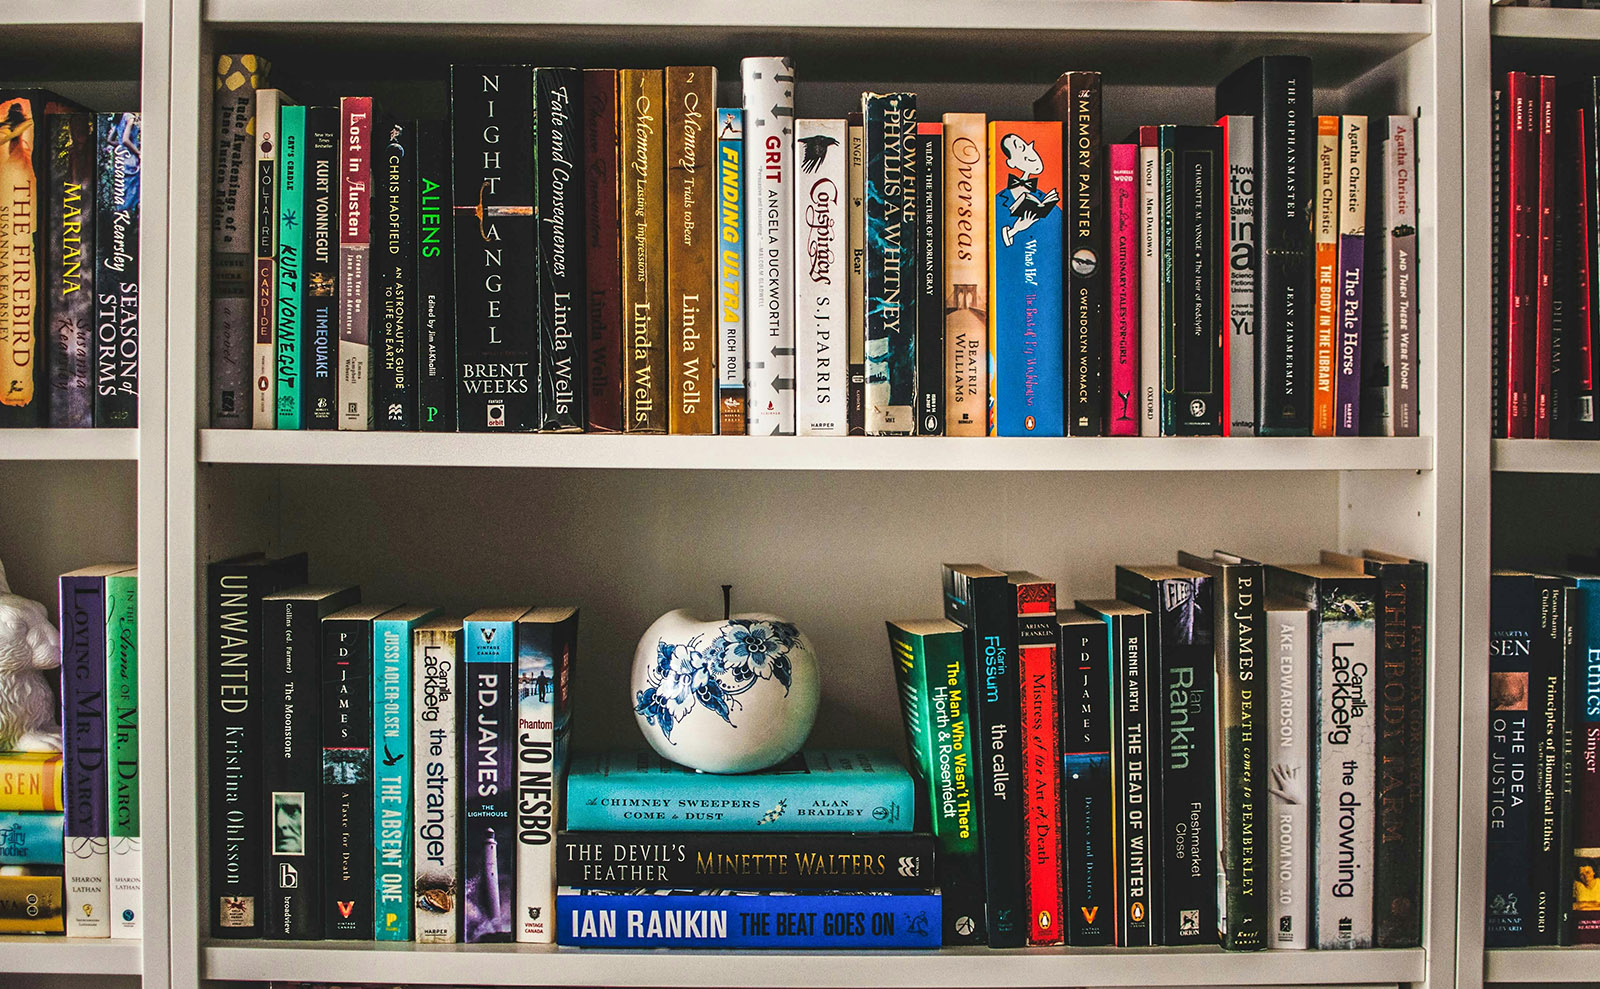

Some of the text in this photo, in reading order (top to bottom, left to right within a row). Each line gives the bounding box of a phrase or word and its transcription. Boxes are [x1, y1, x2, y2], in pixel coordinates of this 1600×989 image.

[235, 97, 249, 128] Rude
[1287, 79, 1296, 219] THE ORPHANMASTER
[226, 134, 245, 211] Awakenings
[286, 135, 295, 191] CAT'S CRADLE
[347, 112, 367, 236] Lost in Austen
[544, 86, 572, 277] Fate and Consequences
[766, 135, 781, 184] GRIT
[852, 137, 862, 167] ENGEL
[1195, 164, 1203, 208] CHARLOTTE
[225, 218, 236, 230] of
[422, 178, 440, 257] ALIENS
[722, 147, 739, 323] FINDING ULTRA
[882, 108, 901, 333] PHYLLIS A. WHITNEY
[925, 142, 934, 296] WILDE THE PICTURE OF DORIAN GRAY
[952, 137, 981, 261] Overseas
[1195, 211, 1203, 221] M.
[13, 180, 31, 367] THE FIREBIRD
[62, 182, 82, 296] MARIANA
[768, 189, 780, 337] ANGELA DUCKWORTH
[853, 248, 863, 275] Bear
[1024, 240, 1038, 285] What Ho!
[428, 295, 436, 317] Edited
[1193, 302, 1202, 336] Redclyffe
[1195, 276, 1203, 291] Heir
[1399, 250, 1408, 390] AND THEN THERE WERE NONE
[98, 293, 116, 397] STORMS
[118, 282, 139, 395] SEASON of
[315, 307, 328, 378] TIMEQUAKE
[385, 287, 394, 370] TO LIFE ON EARTH
[395, 267, 405, 389] AN ASTRONAUT'S GUIDE
[426, 320, 436, 328] by
[428, 330, 436, 342] Jim
[554, 293, 572, 414] Linda Wells
[727, 328, 737, 380] RICH ROLL
[1079, 288, 1088, 403] GWENDOLYN WOMACK
[1285, 286, 1293, 395] JEAN ZIMMERMAN
[1318, 265, 1332, 392] THE BODY IN THE LIBRARY
[1343, 269, 1359, 375] The Pale Horse
[1552, 300, 1562, 375] DILEMMA
[463, 364, 528, 378] BRENT
[463, 380, 528, 393] WEEKS
[954, 333, 966, 402] WILLIAMS
[968, 340, 979, 395] BEATRIZ
[219, 575, 249, 713] UNWANTED
[284, 603, 293, 674] Collins (ed. Farmer)
[1541, 589, 1549, 629] Childress
[1550, 589, 1559, 639] Beauchamp
[384, 631, 400, 738] JUSSI ADLER-OLSEN
[984, 636, 1001, 703] Fossum
[284, 682, 294, 759] The Moonstone
[519, 718, 553, 729] Phantom
[1169, 667, 1193, 770] Rankin
[421, 729, 449, 866] the stranger
[991, 724, 1009, 800] the caller
[1241, 689, 1254, 896] DEATH comes to PEMBERLEY
[1492, 719, 1506, 829] OF JUSTICE
[1511, 718, 1525, 807] THE IDEA
[1543, 676, 1557, 852] Principles of Biomedical Ethics
[341, 802, 350, 829] Taste
[341, 833, 350, 848] for
[381, 776, 402, 903] THE ABSENT ONE
[798, 809, 863, 817] BRADLEY
[1128, 723, 1144, 897] THE DEAD OF WINTER
[1175, 822, 1188, 859] Close
[1190, 802, 1202, 878] Fleshmarket
[1333, 760, 1361, 898] the drowning
[342, 852, 350, 882] Death
[566, 844, 685, 861] THE DEVIL'S
[583, 864, 669, 881] FEATHER
[1084, 797, 1094, 900] Devices and Desires
[283, 896, 292, 934] broadview
[572, 910, 727, 938] IAN RANKIN
[740, 913, 894, 936] THE BEAT GOES ON
